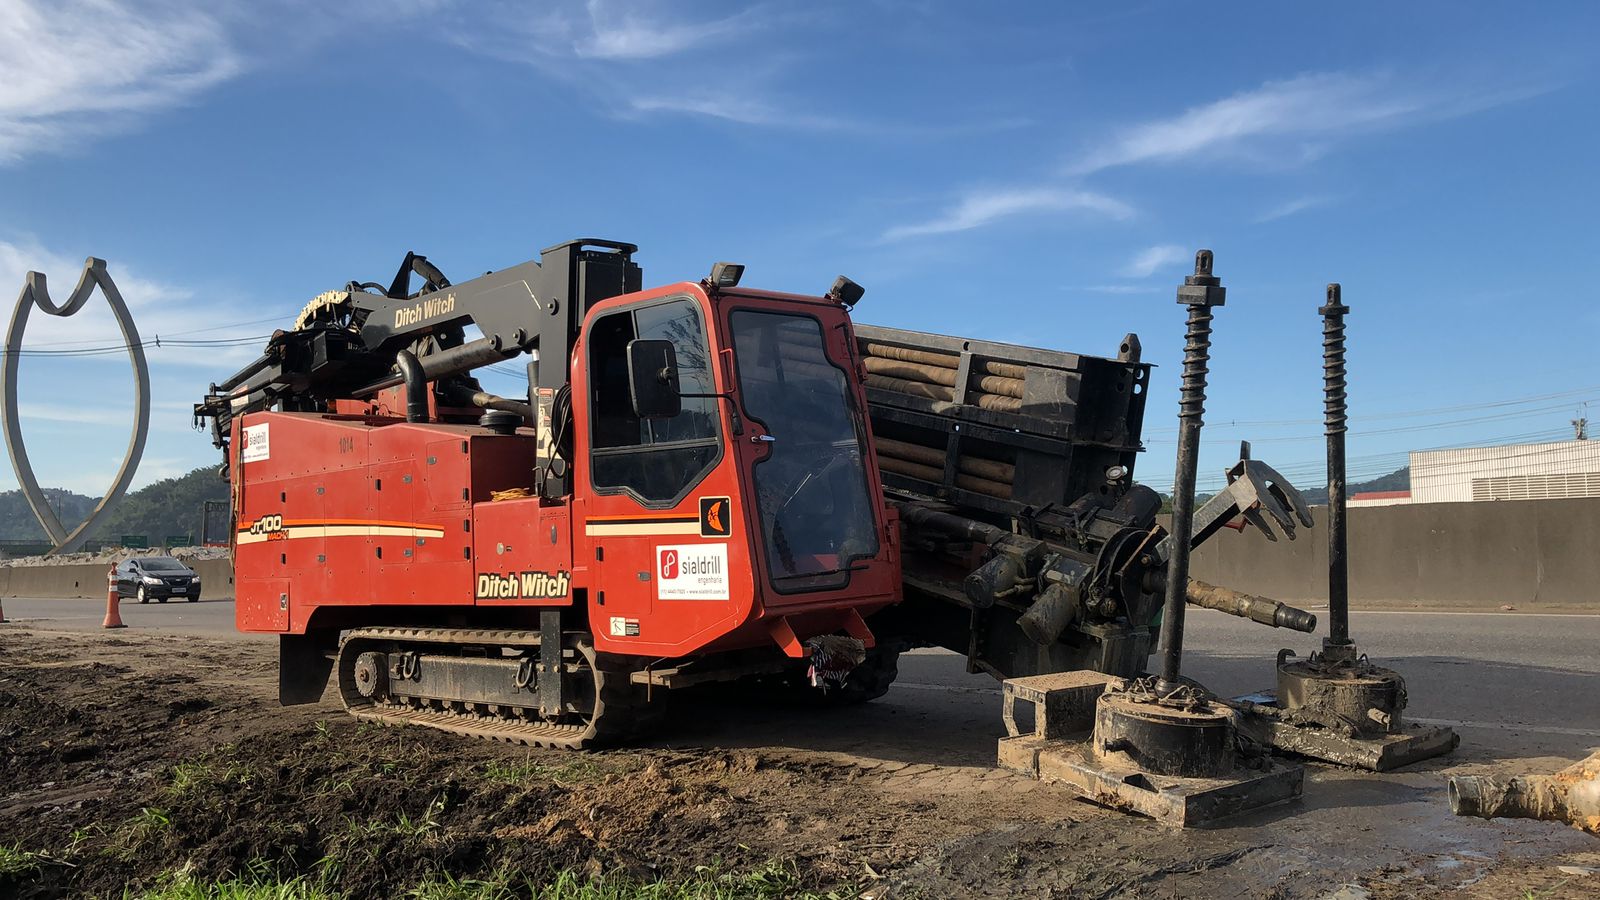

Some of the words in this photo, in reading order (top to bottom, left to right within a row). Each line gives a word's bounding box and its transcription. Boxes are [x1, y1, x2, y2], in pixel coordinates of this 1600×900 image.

[394, 303, 422, 329] Ditch
[424, 293, 455, 320] Witch
[339, 436, 354, 454] 1014
[250, 514, 283, 535] JT100
[682, 555, 721, 575] sialdrill
[477, 573, 519, 599] Ditch
[521, 571, 569, 598] Witch
[697, 576, 722, 586] engenharia
